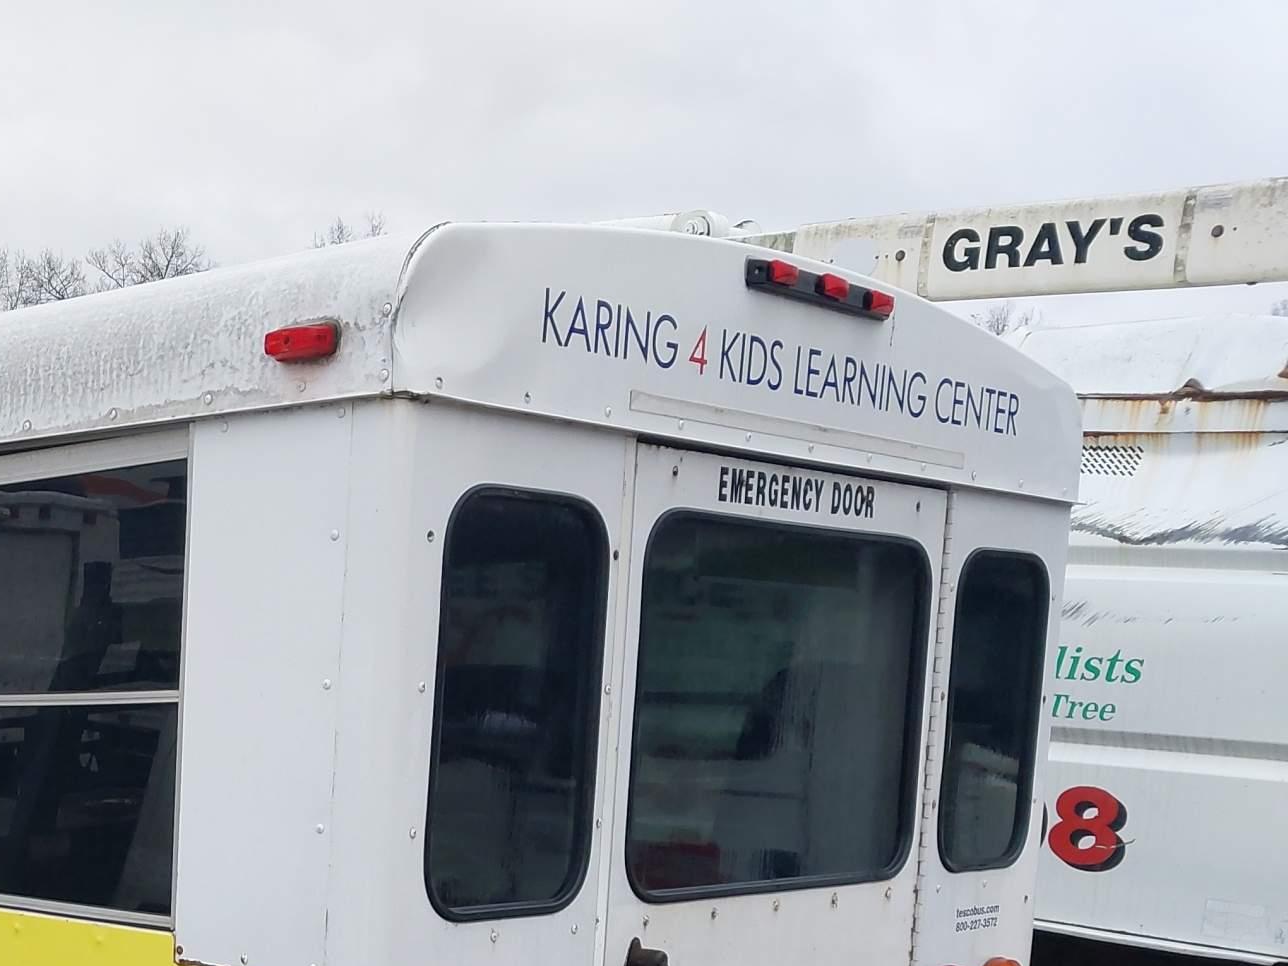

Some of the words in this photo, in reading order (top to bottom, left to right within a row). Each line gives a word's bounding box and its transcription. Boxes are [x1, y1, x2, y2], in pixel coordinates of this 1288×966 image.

[942, 213, 1166, 272] GRAY'S
[541, 287, 679, 370] KARING
[688, 325, 708, 376] 4
[719, 329, 784, 391] KIDS
[793, 345, 928, 419] LEARNING
[935, 377, 1020, 437] CENTER
[718, 466, 825, 514] EMERGENCY
[830, 482, 876, 519] DOOR
[1040, 785, 1128, 872] 8
[956, 905, 1000, 919] tescobus.com
